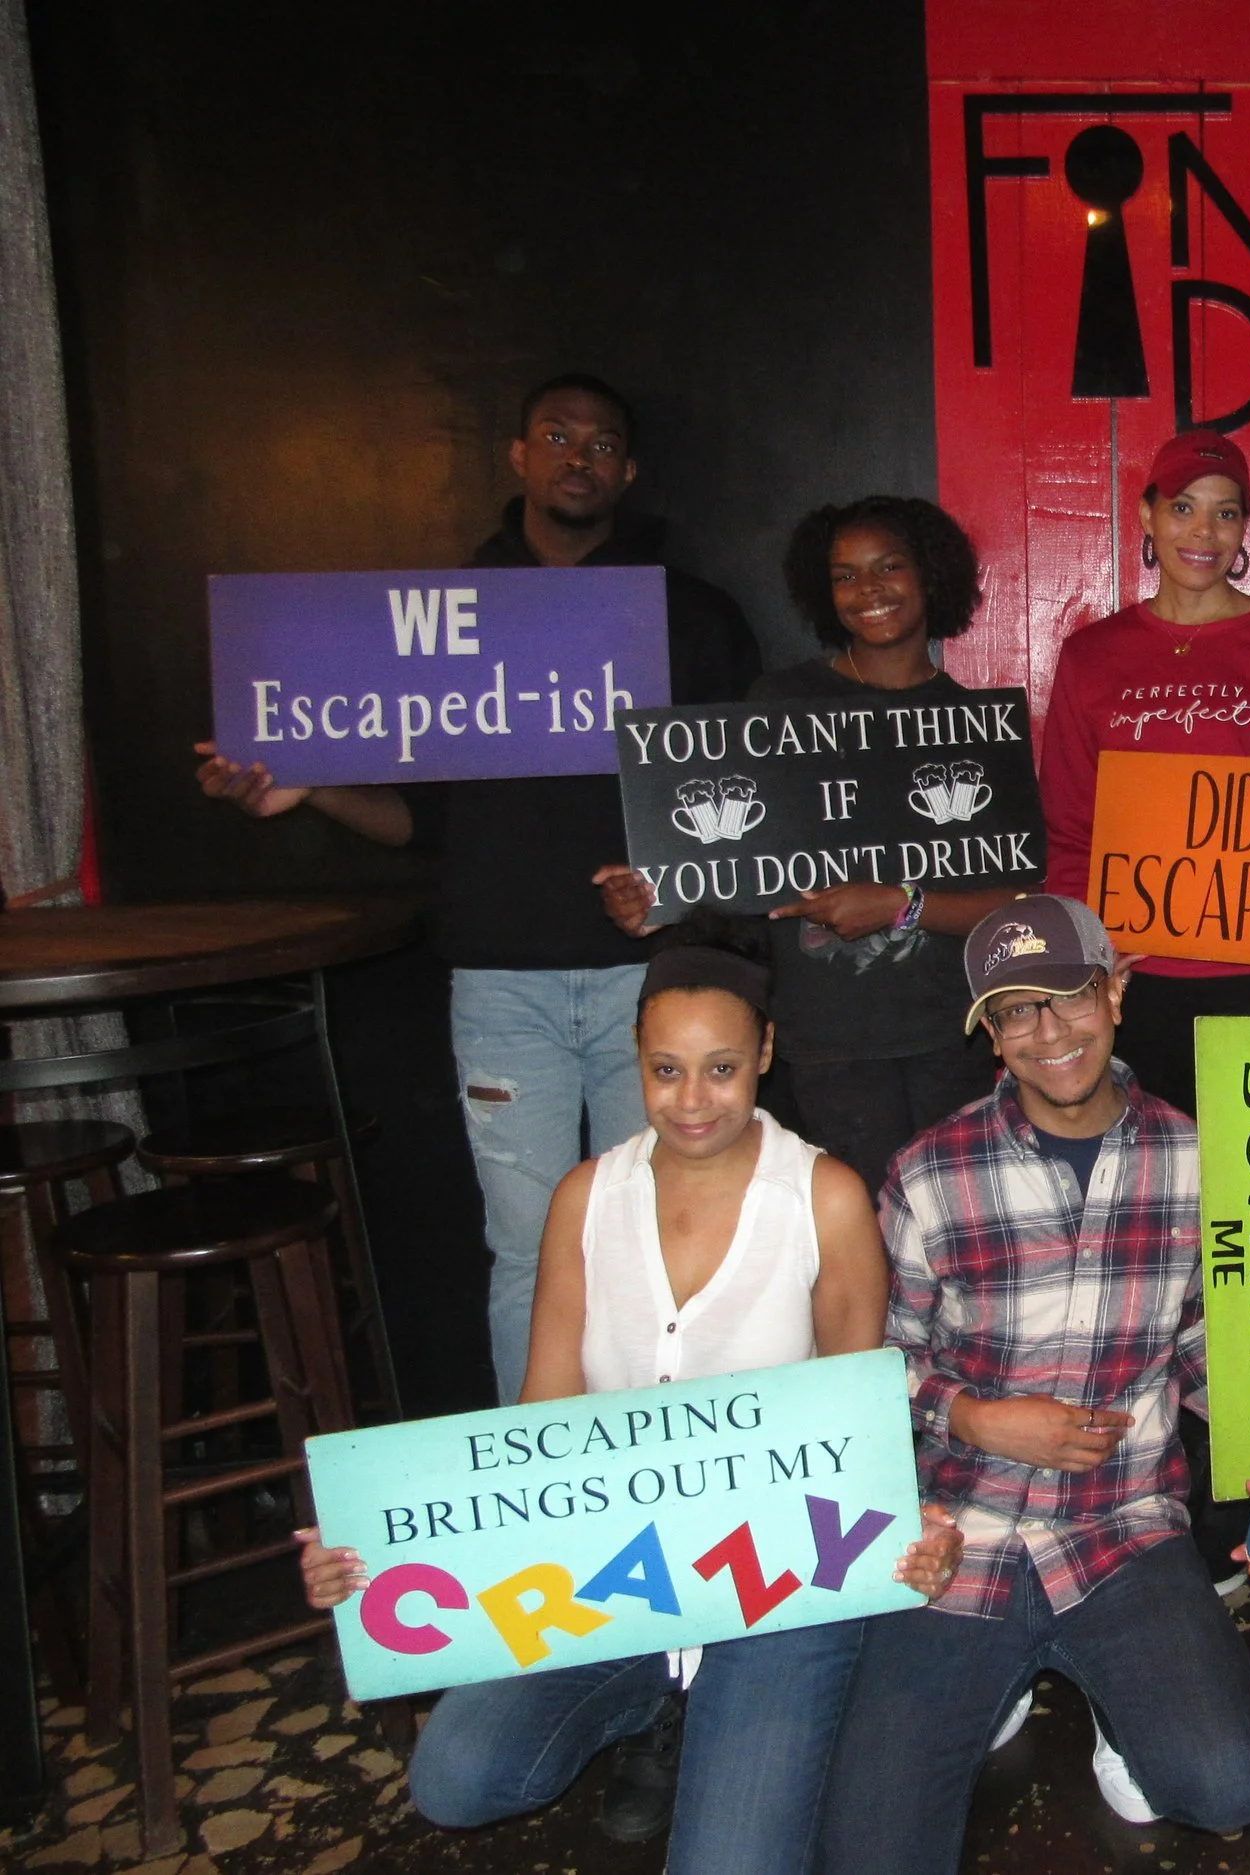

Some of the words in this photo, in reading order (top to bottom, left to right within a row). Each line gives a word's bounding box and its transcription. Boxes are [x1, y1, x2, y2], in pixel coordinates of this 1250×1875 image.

[387, 588, 481, 657] WE
[252, 661, 634, 763] Escaped-ish
[1122, 684, 1244, 700] PERFECTLY
[626, 719, 729, 765] YOU
[743, 711, 876, 758] CAN'T
[886, 704, 1022, 749] THINK
[819, 779, 859, 822] IF
[637, 858, 739, 907] YOU
[754, 844, 887, 896] DON'T
[899, 832, 1038, 882] DRINK
[1210, 1220, 1245, 1289] ME
[466, 1391, 764, 1472] ESCAPING
[383, 1474, 610, 1546] BRINGS
[627, 1454, 747, 1506] OUT
[766, 1436, 855, 1484] MY
[359, 1494, 897, 1669] CRAZY
